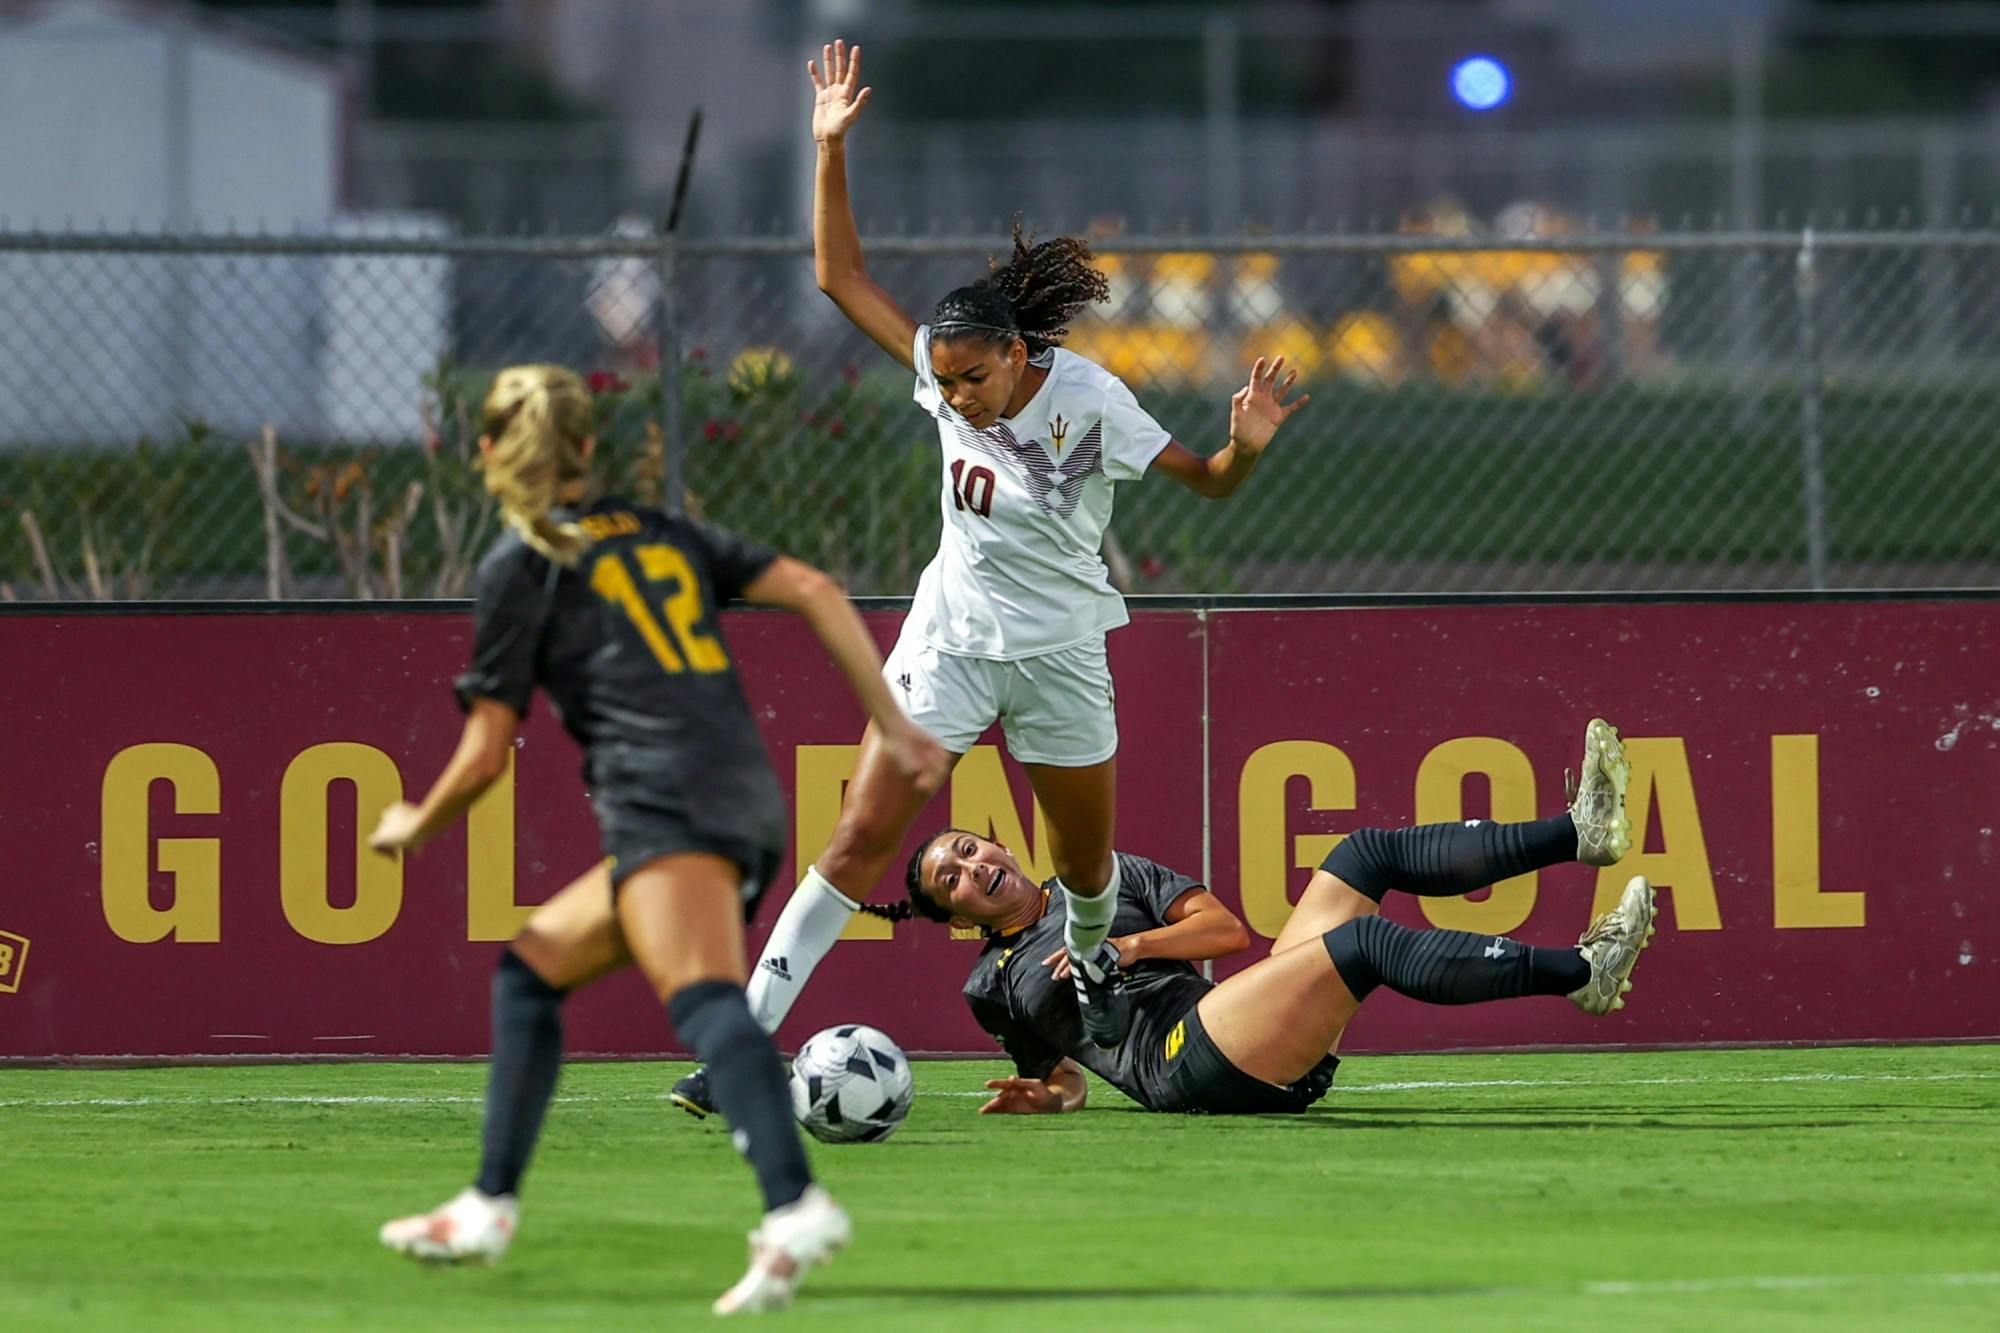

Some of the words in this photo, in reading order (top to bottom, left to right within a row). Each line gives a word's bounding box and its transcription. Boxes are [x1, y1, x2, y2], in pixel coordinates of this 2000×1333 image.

[950, 459, 996, 518] 10
[590, 543, 730, 673] 12
[102, 742, 1057, 944] GOLEN
[1238, 733, 1866, 940] GOAL
